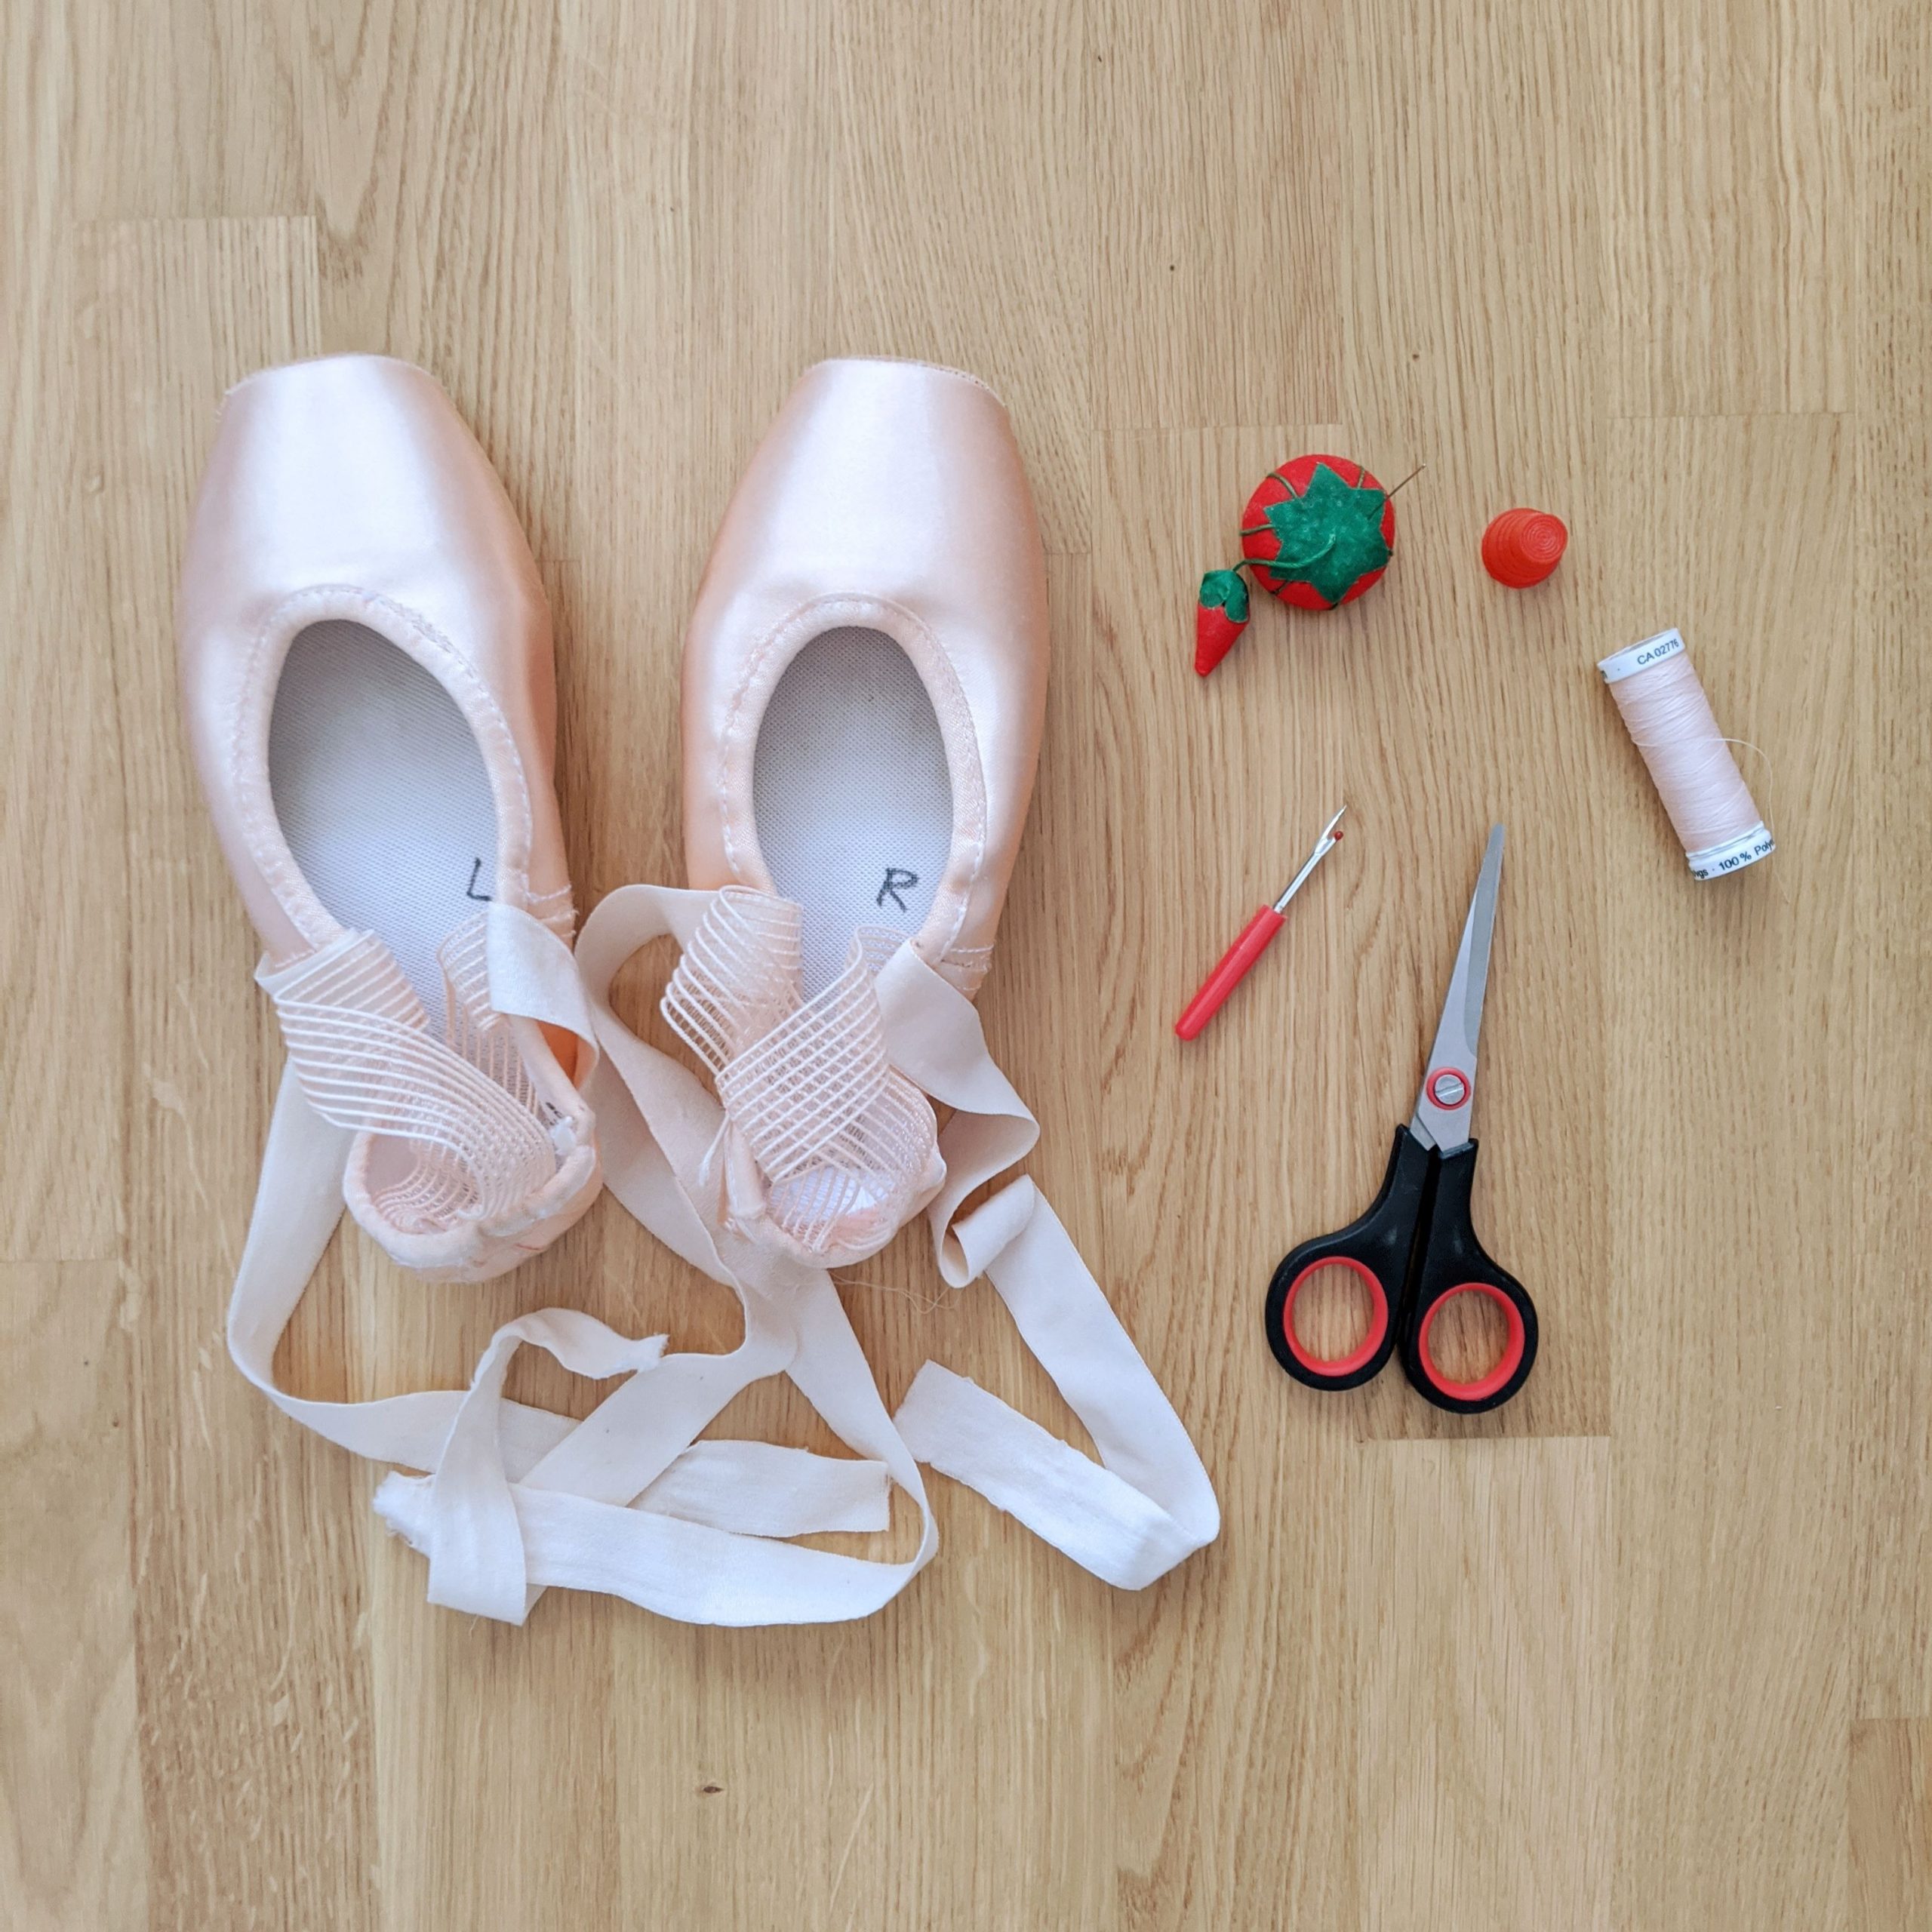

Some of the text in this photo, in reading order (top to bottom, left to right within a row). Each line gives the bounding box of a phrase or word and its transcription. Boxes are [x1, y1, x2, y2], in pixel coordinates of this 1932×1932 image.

[1637, 638, 1679, 665] CA 02776
[1718, 857, 1740, 870] 100
[1740, 851, 1752, 862] %
[466, 857, 492, 901] L
[876, 868, 918, 913] R
